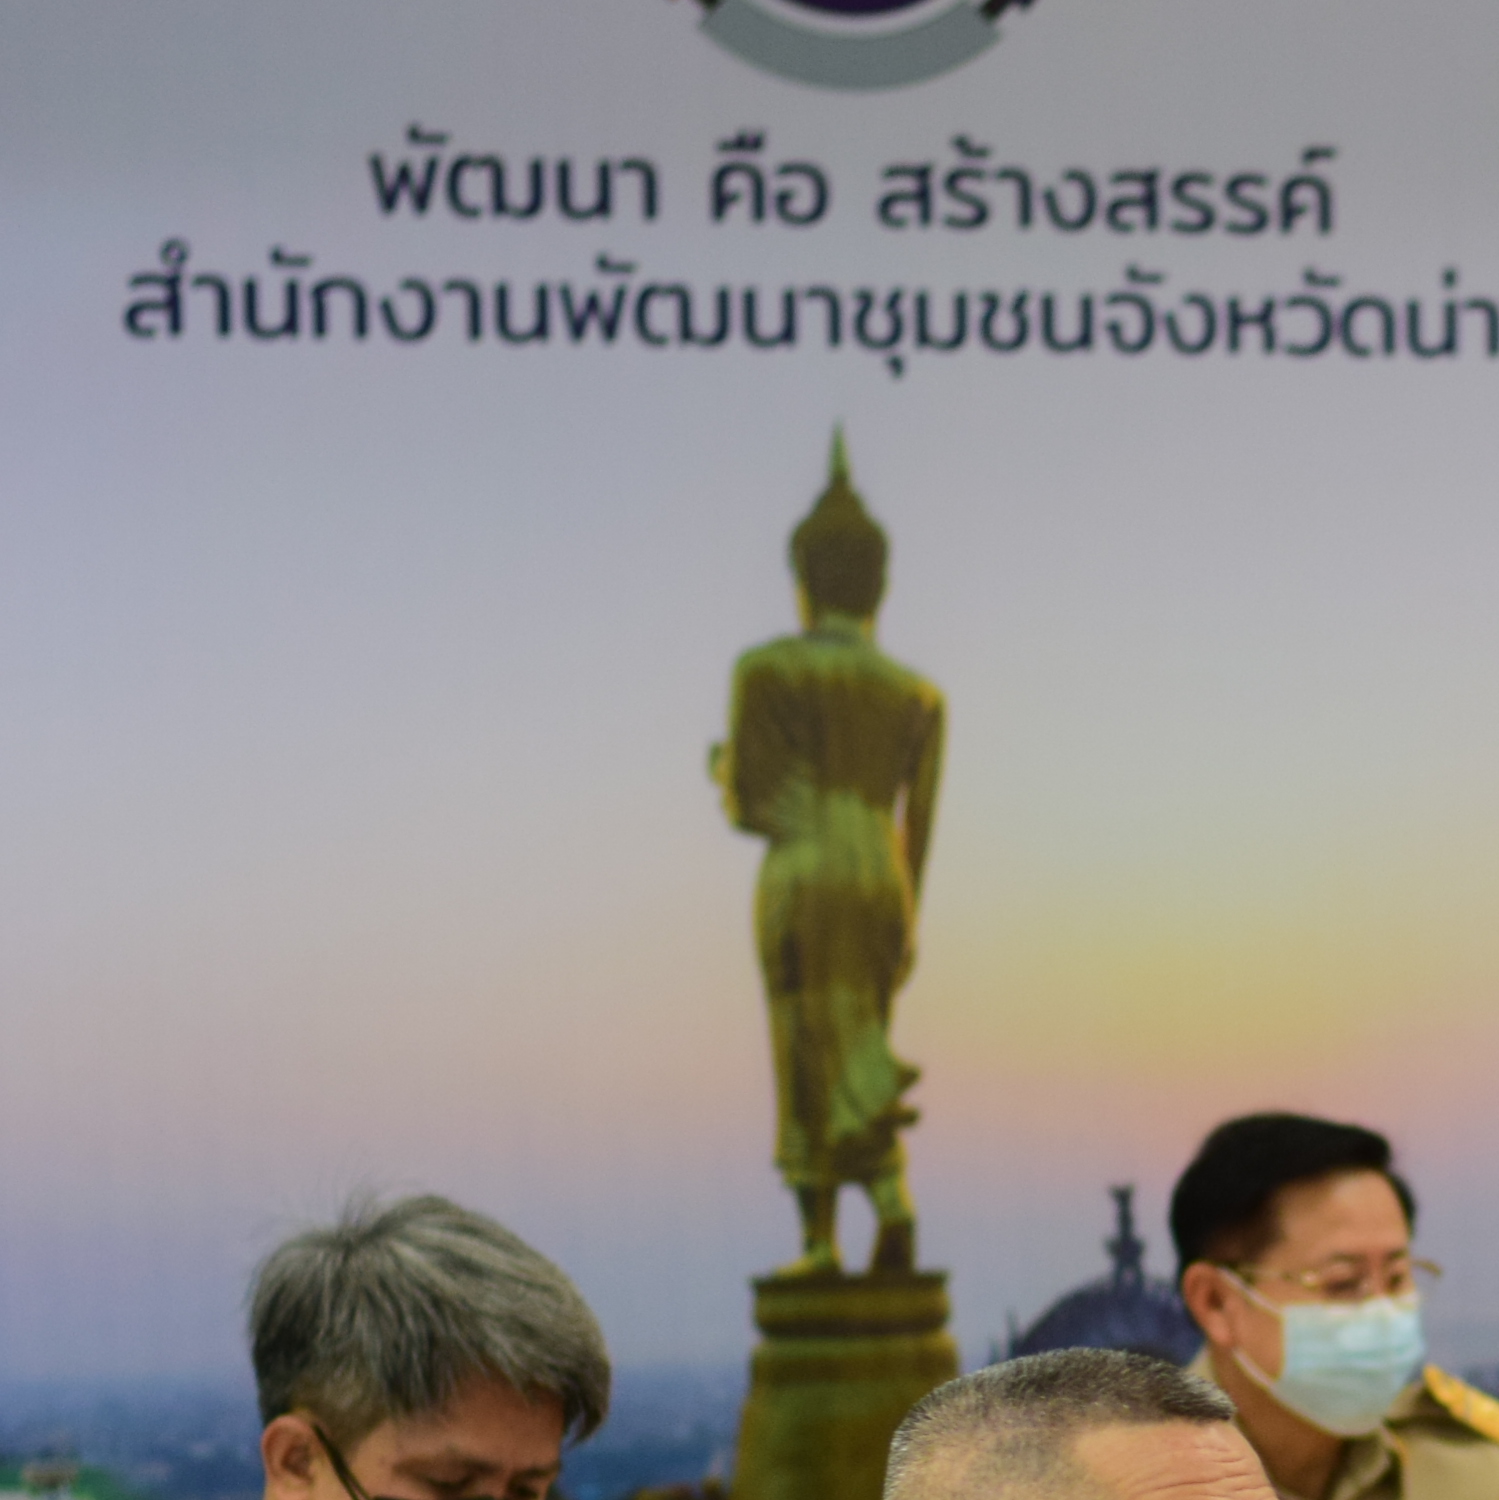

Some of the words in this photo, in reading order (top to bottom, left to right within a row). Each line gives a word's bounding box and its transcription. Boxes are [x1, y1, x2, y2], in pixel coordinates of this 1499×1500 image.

[368, 124, 660, 221] พัฒนา
[710, 131, 830, 227] คือ
[876, 135, 1337, 236] สร้างสรรค์
